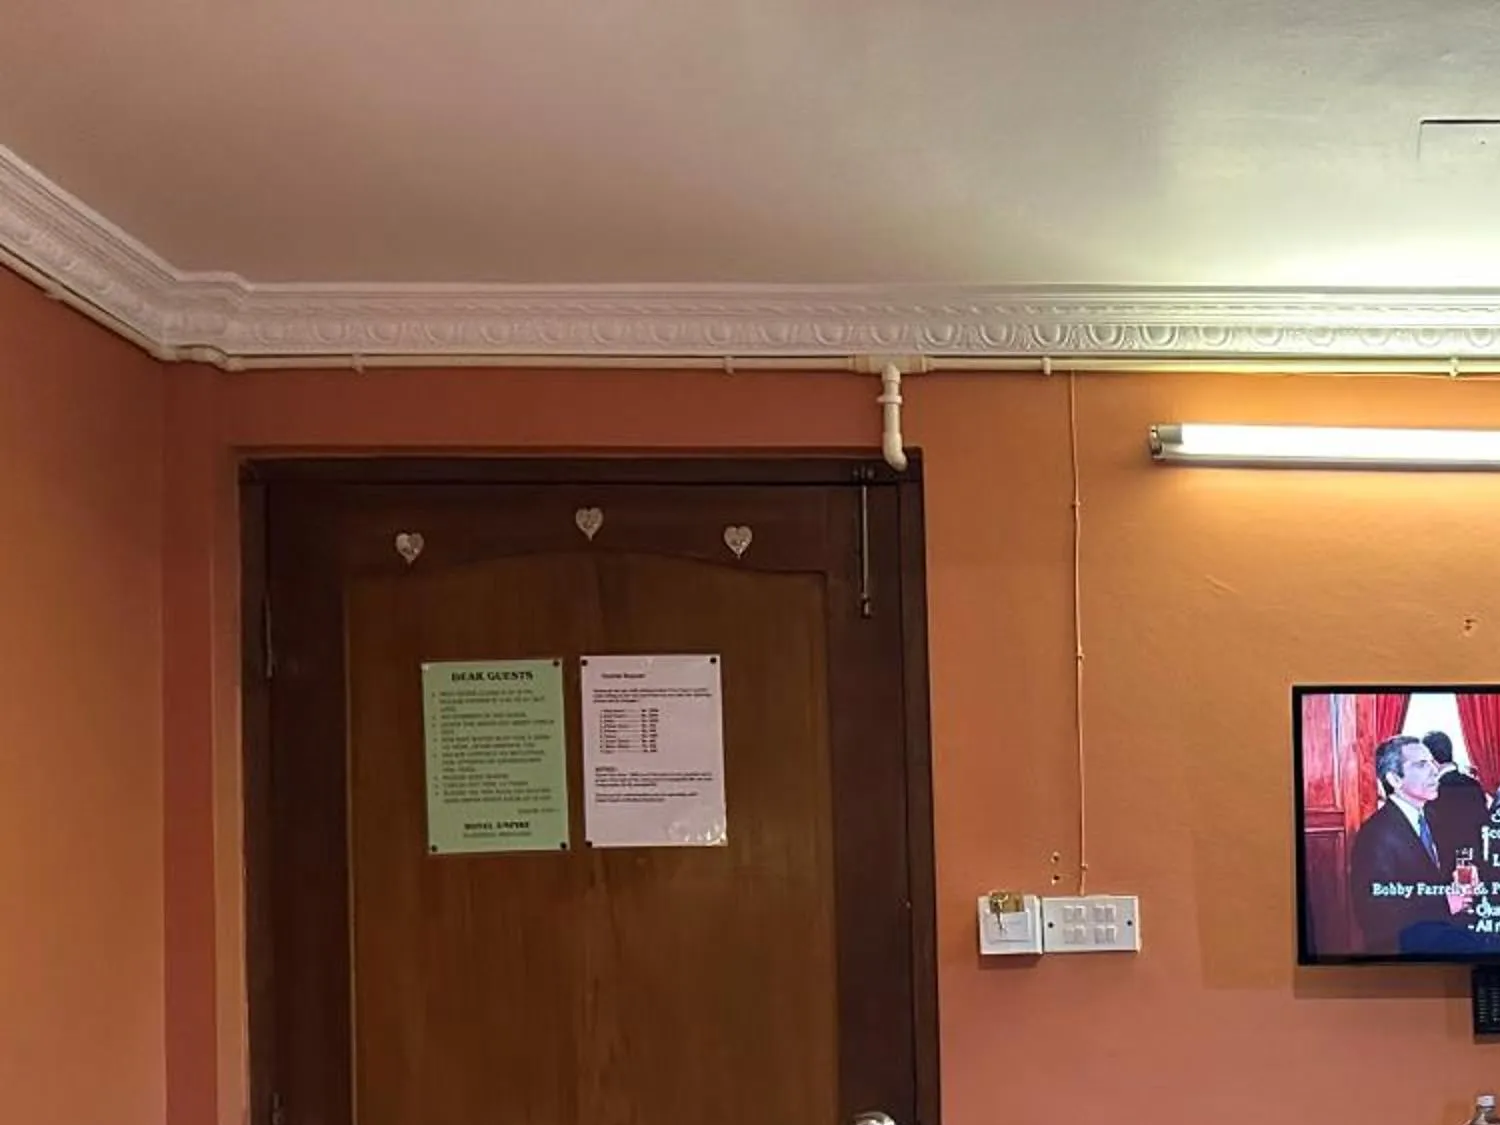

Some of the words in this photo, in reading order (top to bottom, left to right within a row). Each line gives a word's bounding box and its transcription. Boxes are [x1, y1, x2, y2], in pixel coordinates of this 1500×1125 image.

[451, 671, 485, 681] DEAR
[487, 670, 534, 681] GUESTS
[1372, 883, 1416, 899] Bobby
[1475, 920, 1493, 932] All
